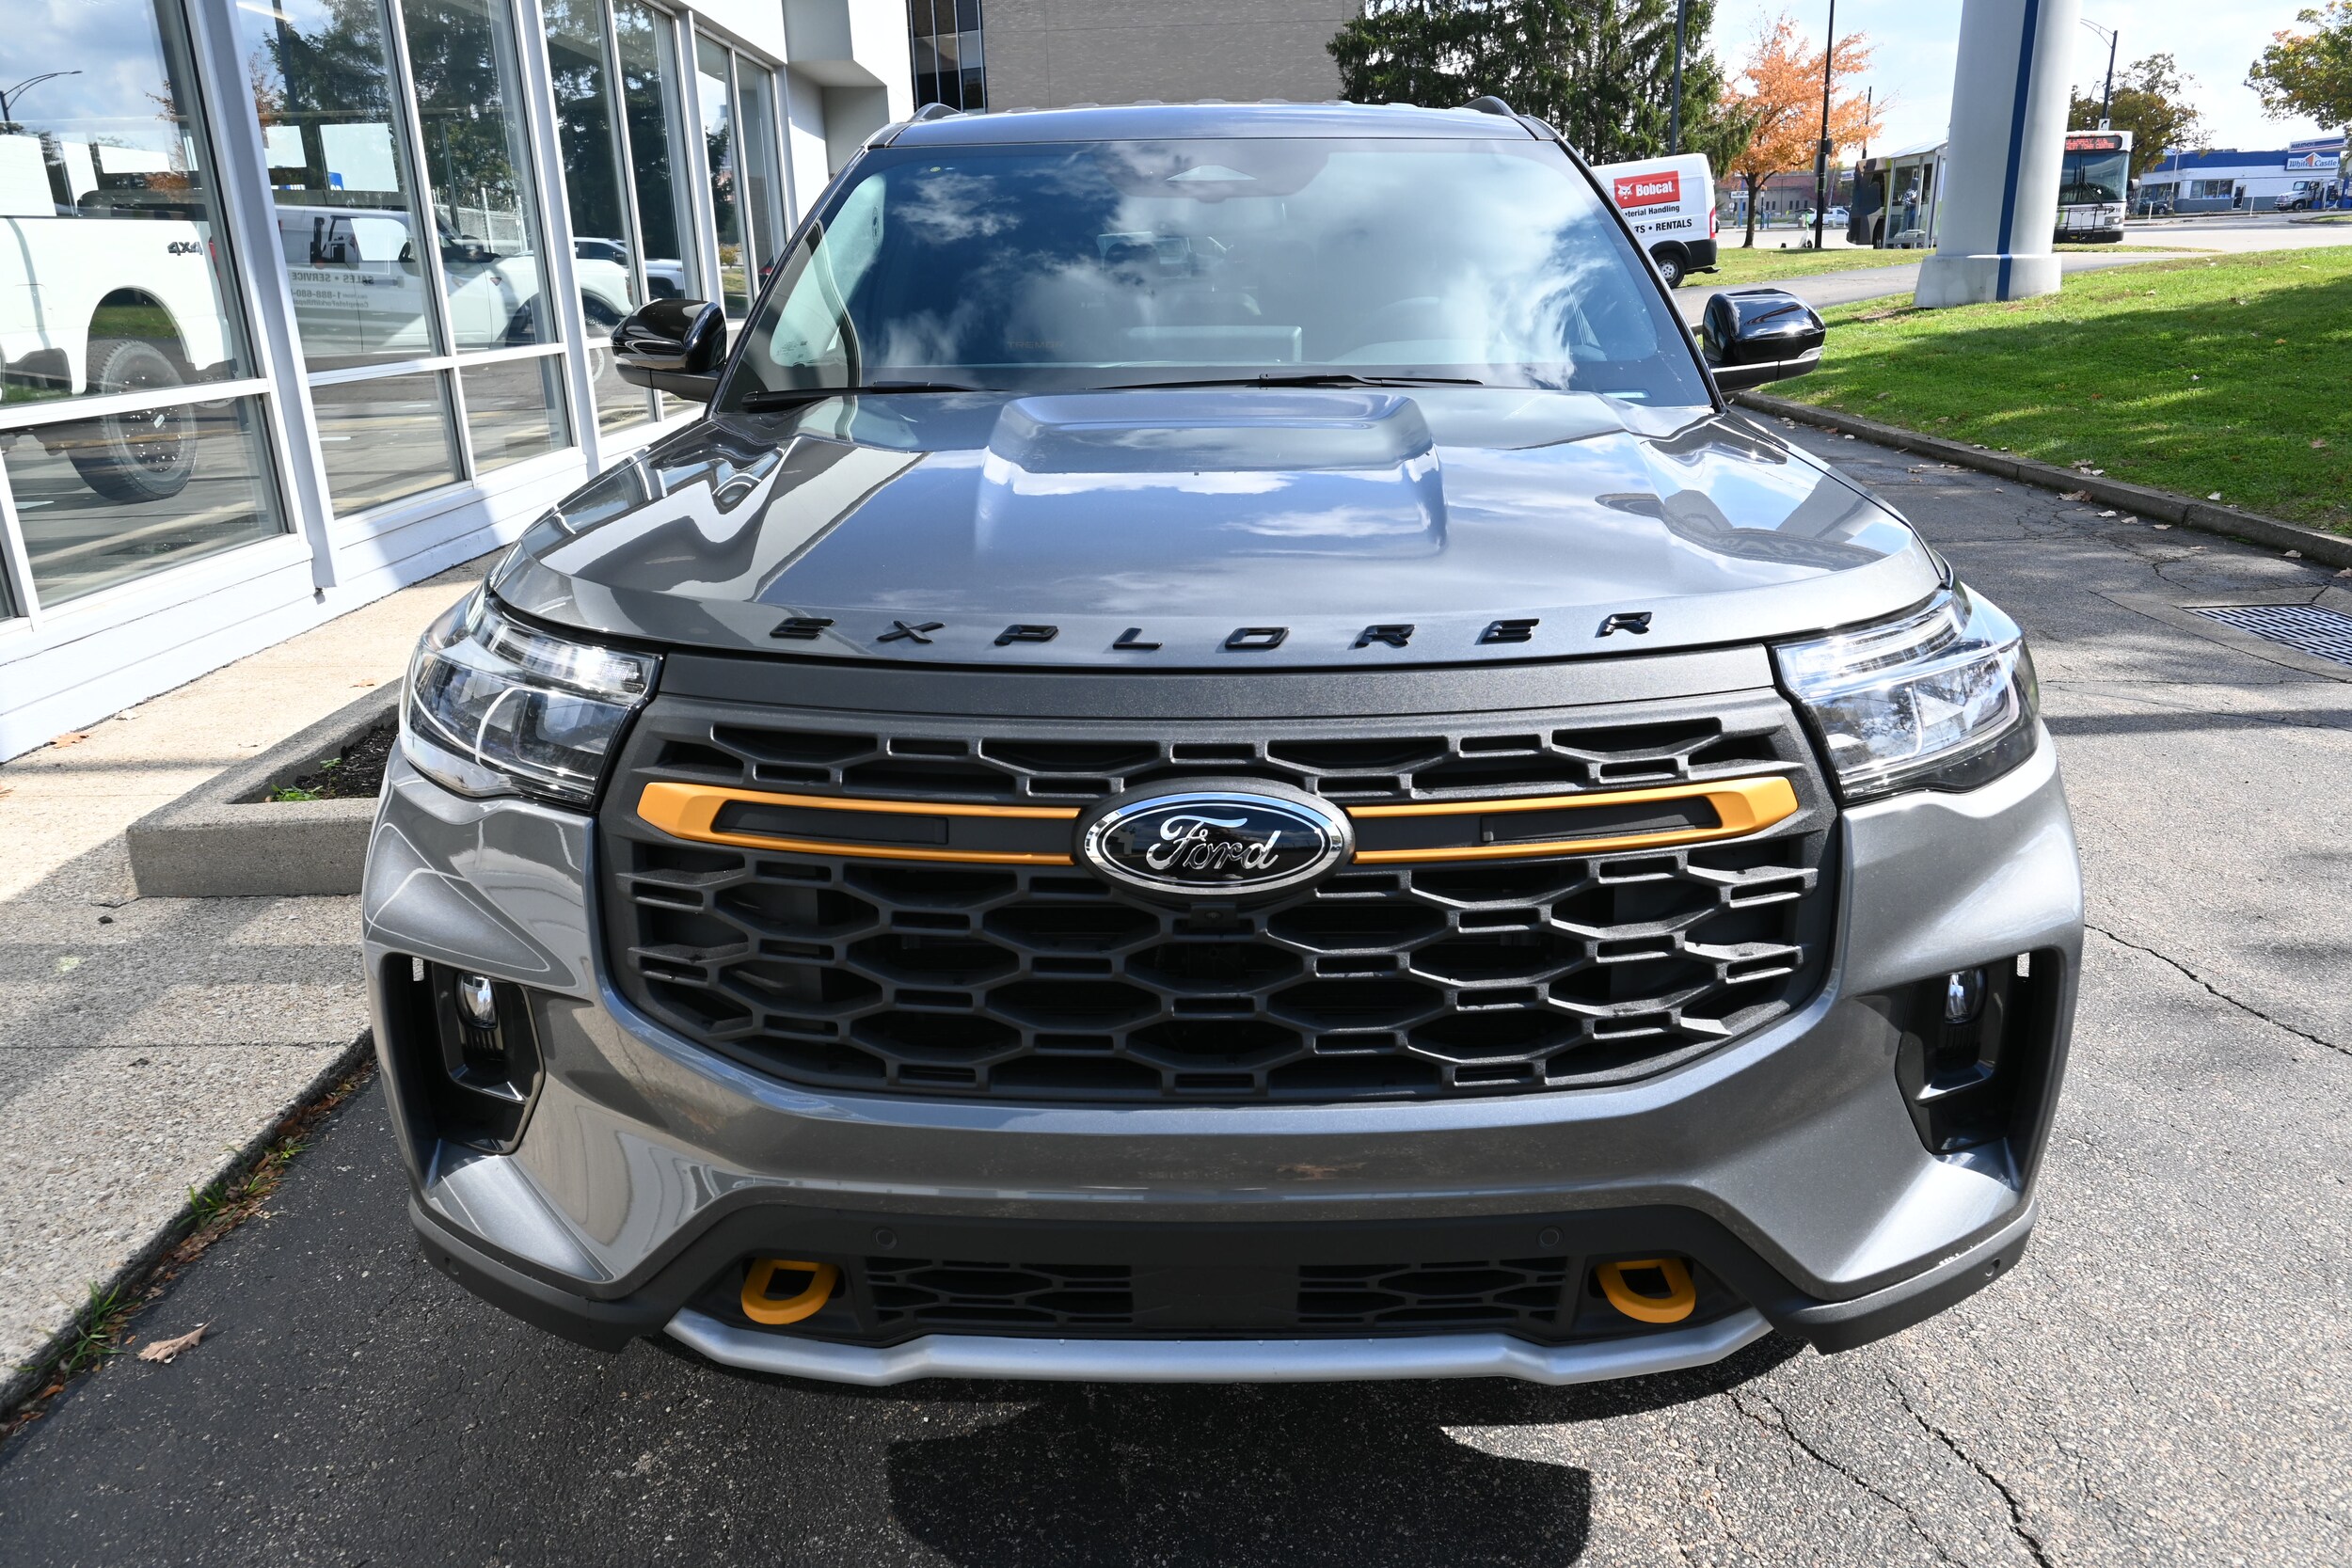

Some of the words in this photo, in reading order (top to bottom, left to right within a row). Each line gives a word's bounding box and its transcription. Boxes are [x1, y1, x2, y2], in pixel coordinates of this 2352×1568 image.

[2314, 159, 2338, 167] Castle
[1635, 181, 1674, 197] Bobcat
[1648, 205, 1680, 214] Handling
[1634, 225, 1645, 234] TS
[1656, 218, 1692, 232] RENTALS
[770, 611, 1653, 650] EXPLORER
[1146, 815, 1281, 869] Ford
